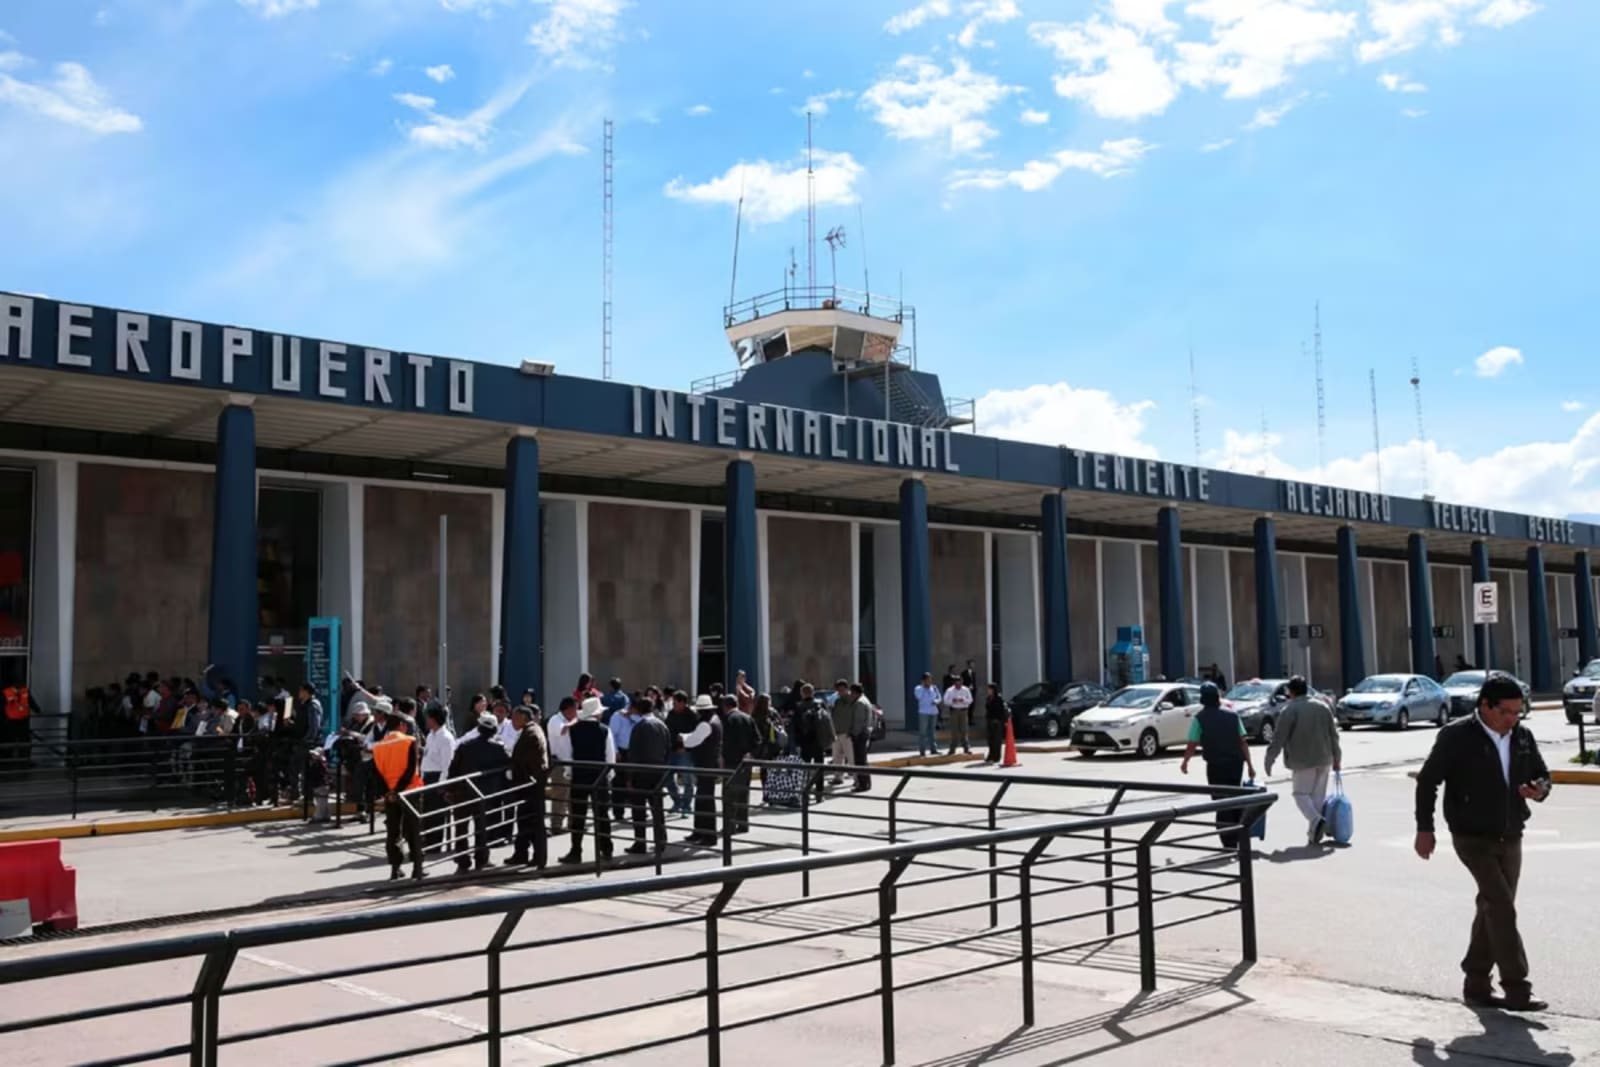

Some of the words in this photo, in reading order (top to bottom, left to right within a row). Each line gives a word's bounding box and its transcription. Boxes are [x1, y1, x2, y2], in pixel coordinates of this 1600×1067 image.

[0, 297, 474, 412] AEROPUERTO
[633, 385, 959, 471] INTERNACIONAL
[1073, 451, 1209, 500] TENIENTE
[1287, 481, 1391, 522] ALEJANDRO
[1432, 502, 1496, 535] VELASCO
[1528, 515, 1574, 544] ASTETE
[1482, 589, 1492, 604] E
